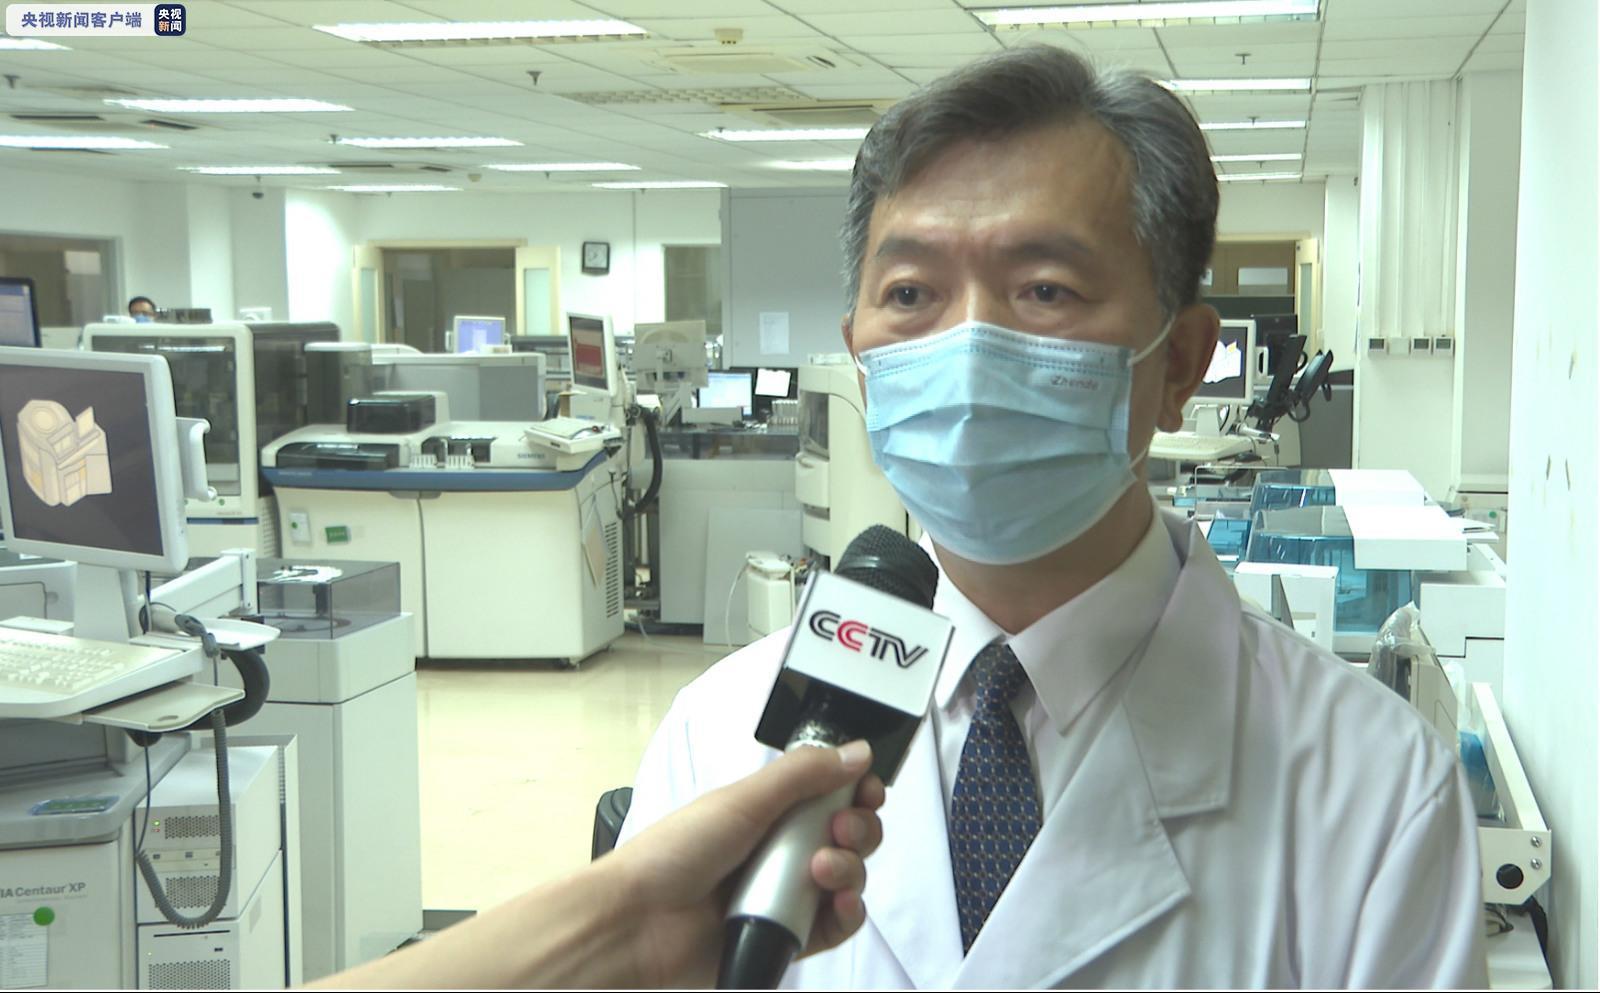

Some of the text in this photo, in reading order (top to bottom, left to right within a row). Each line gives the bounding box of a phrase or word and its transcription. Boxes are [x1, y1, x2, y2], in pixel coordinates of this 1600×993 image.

[809, 610, 929, 669] CCTV
[0, 882, 86, 898] IA Centaur XP
